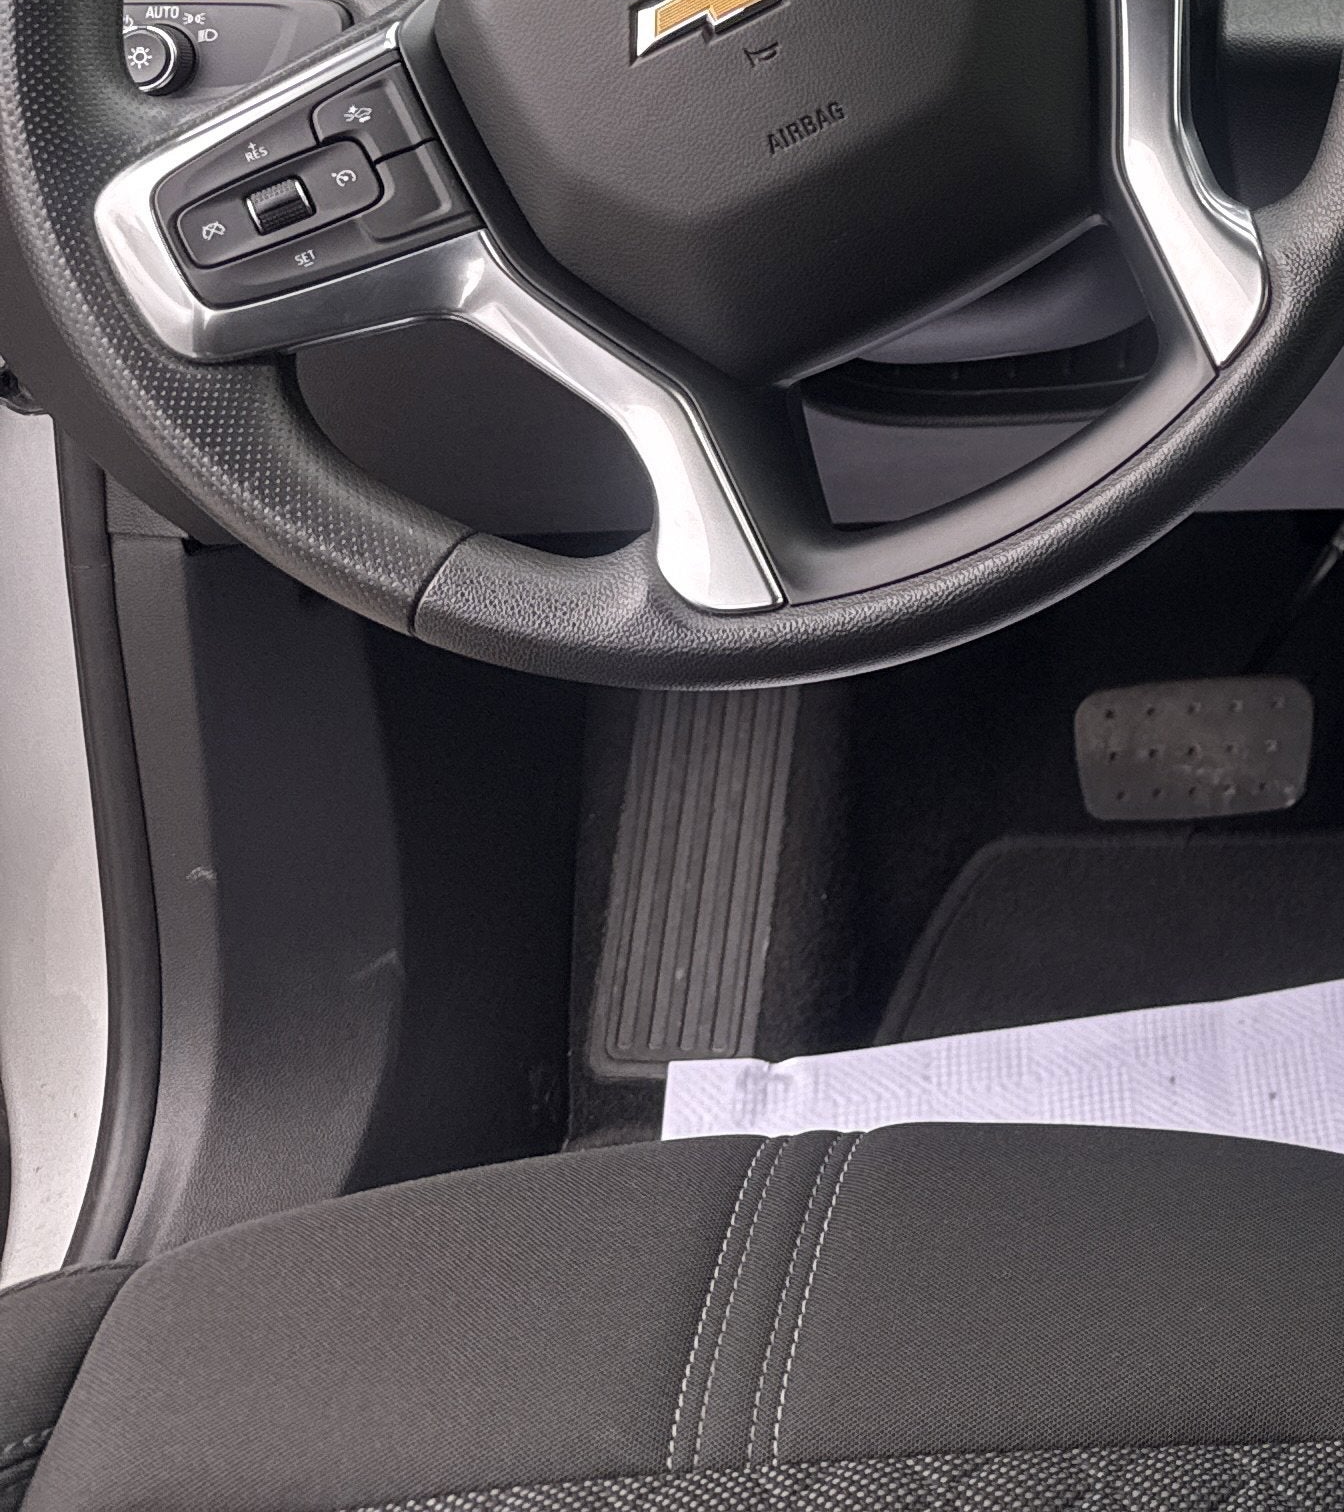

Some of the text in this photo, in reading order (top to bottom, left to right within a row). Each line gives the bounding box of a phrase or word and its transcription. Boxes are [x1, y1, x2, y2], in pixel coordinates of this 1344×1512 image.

[145, 5, 180, 19] AUTO
[767, 101, 846, 155] AIRBAG
[244, 146, 268, 163] RES
[294, 249, 317, 266] SET
